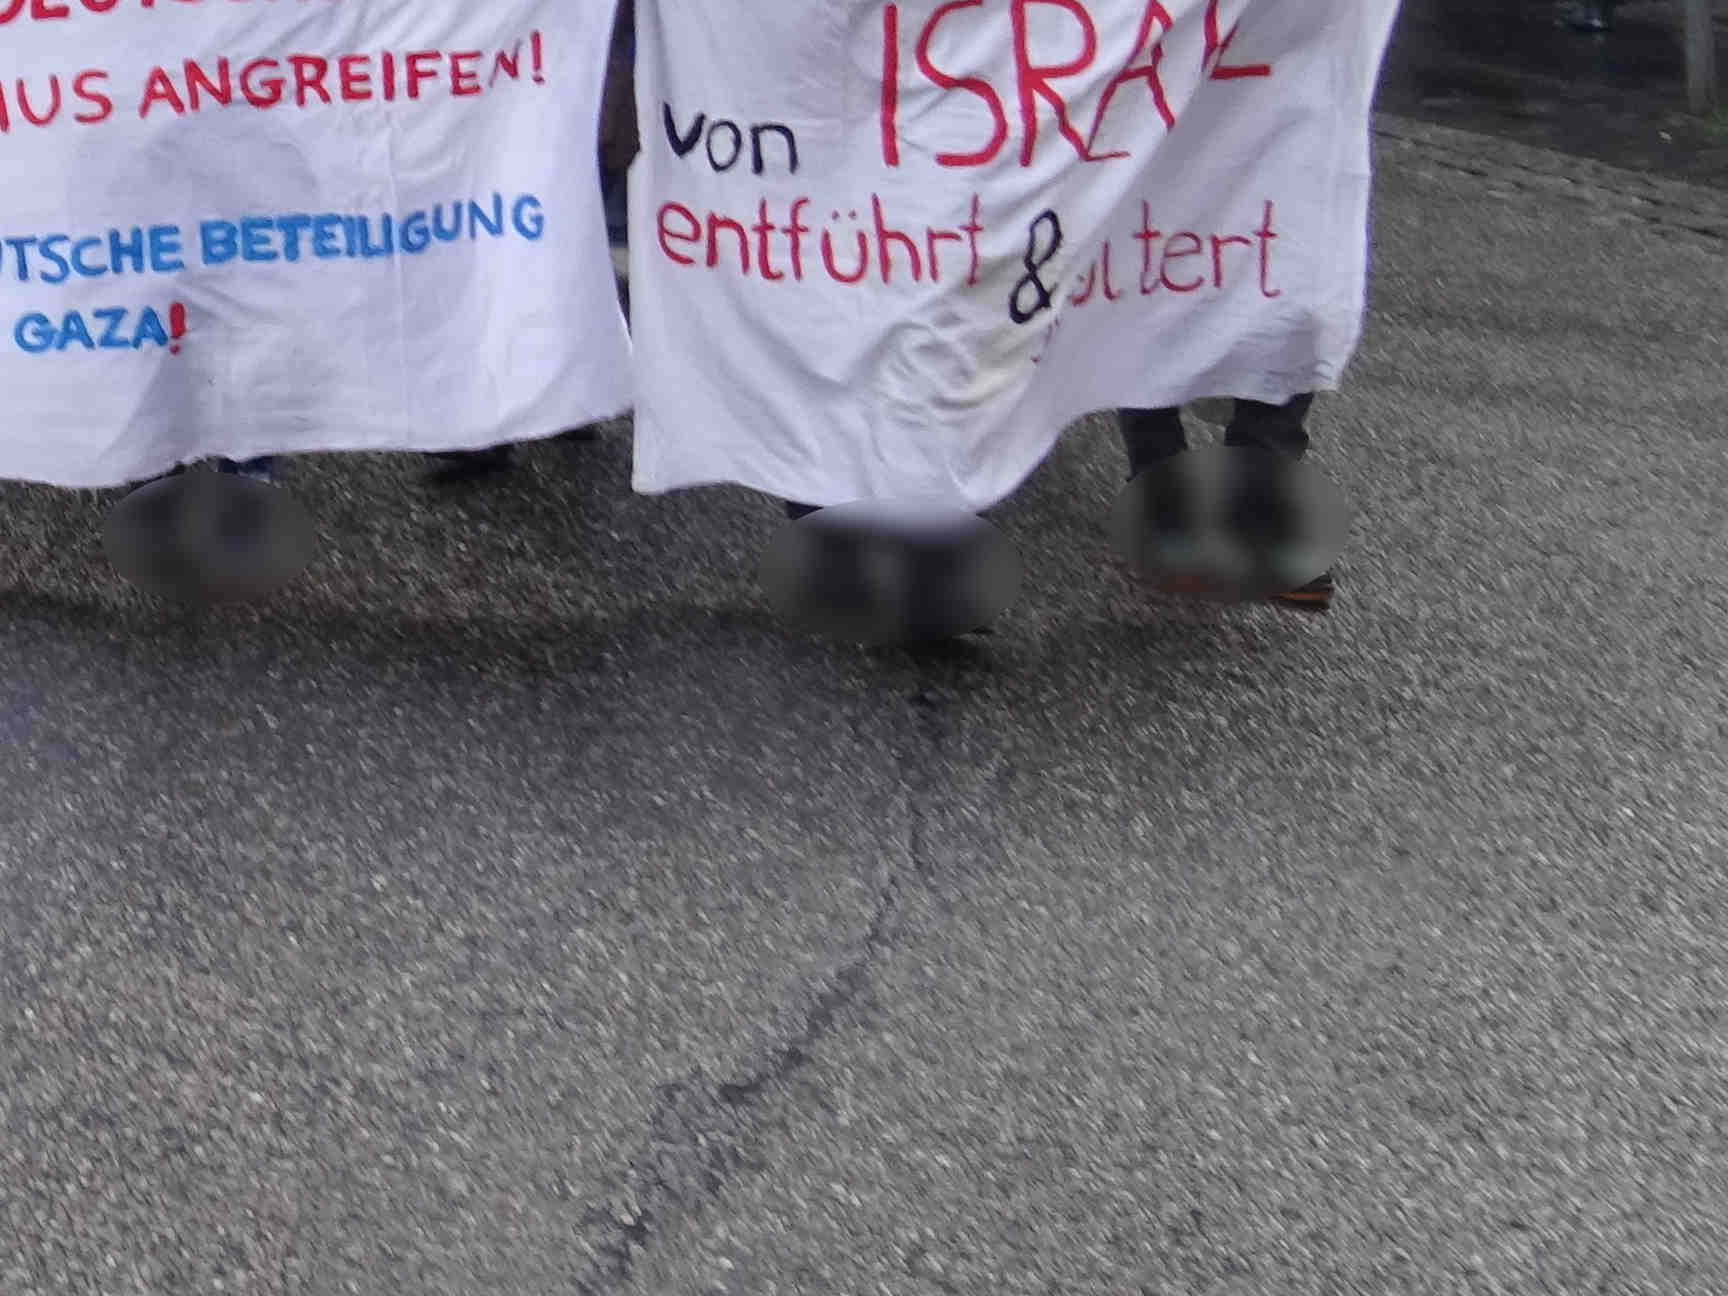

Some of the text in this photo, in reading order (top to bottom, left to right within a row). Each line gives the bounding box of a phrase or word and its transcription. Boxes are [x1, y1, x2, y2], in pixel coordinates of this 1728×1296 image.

[138, 30, 544, 118] ANGREIFEN!
[661, 100, 800, 176] von
[198, 192, 545, 268] BETEILIGUNG
[655, 192, 986, 289] entführt
[1007, 208, 1063, 326] &
[11, 301, 188, 357] GAZA!
